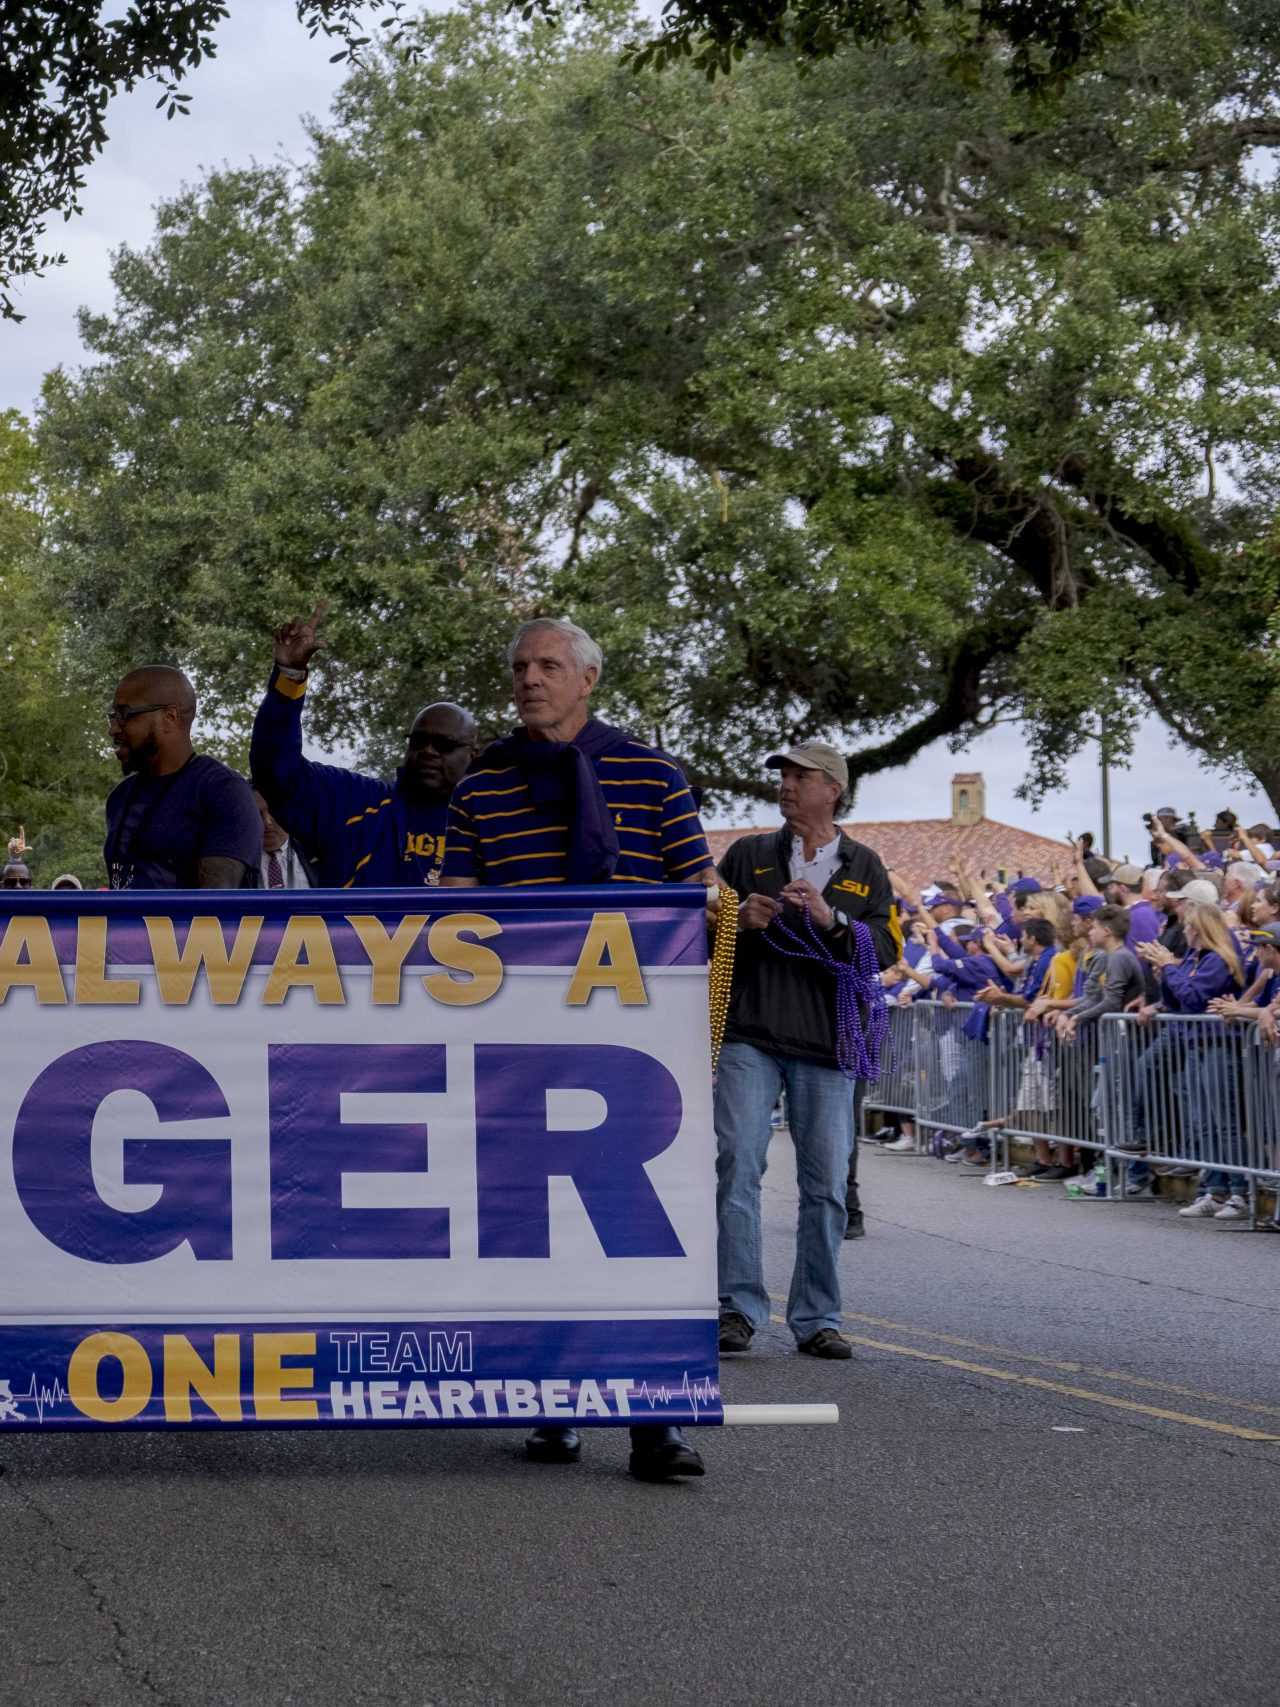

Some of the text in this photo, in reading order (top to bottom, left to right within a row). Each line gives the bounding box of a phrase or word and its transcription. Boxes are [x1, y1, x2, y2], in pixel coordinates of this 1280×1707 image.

[564, 912, 650, 1006] A
[67, 1331, 320, 1423] ONE
[330, 1331, 473, 1374] TEAM
[330, 1378, 635, 1420] HEARTBEAT
